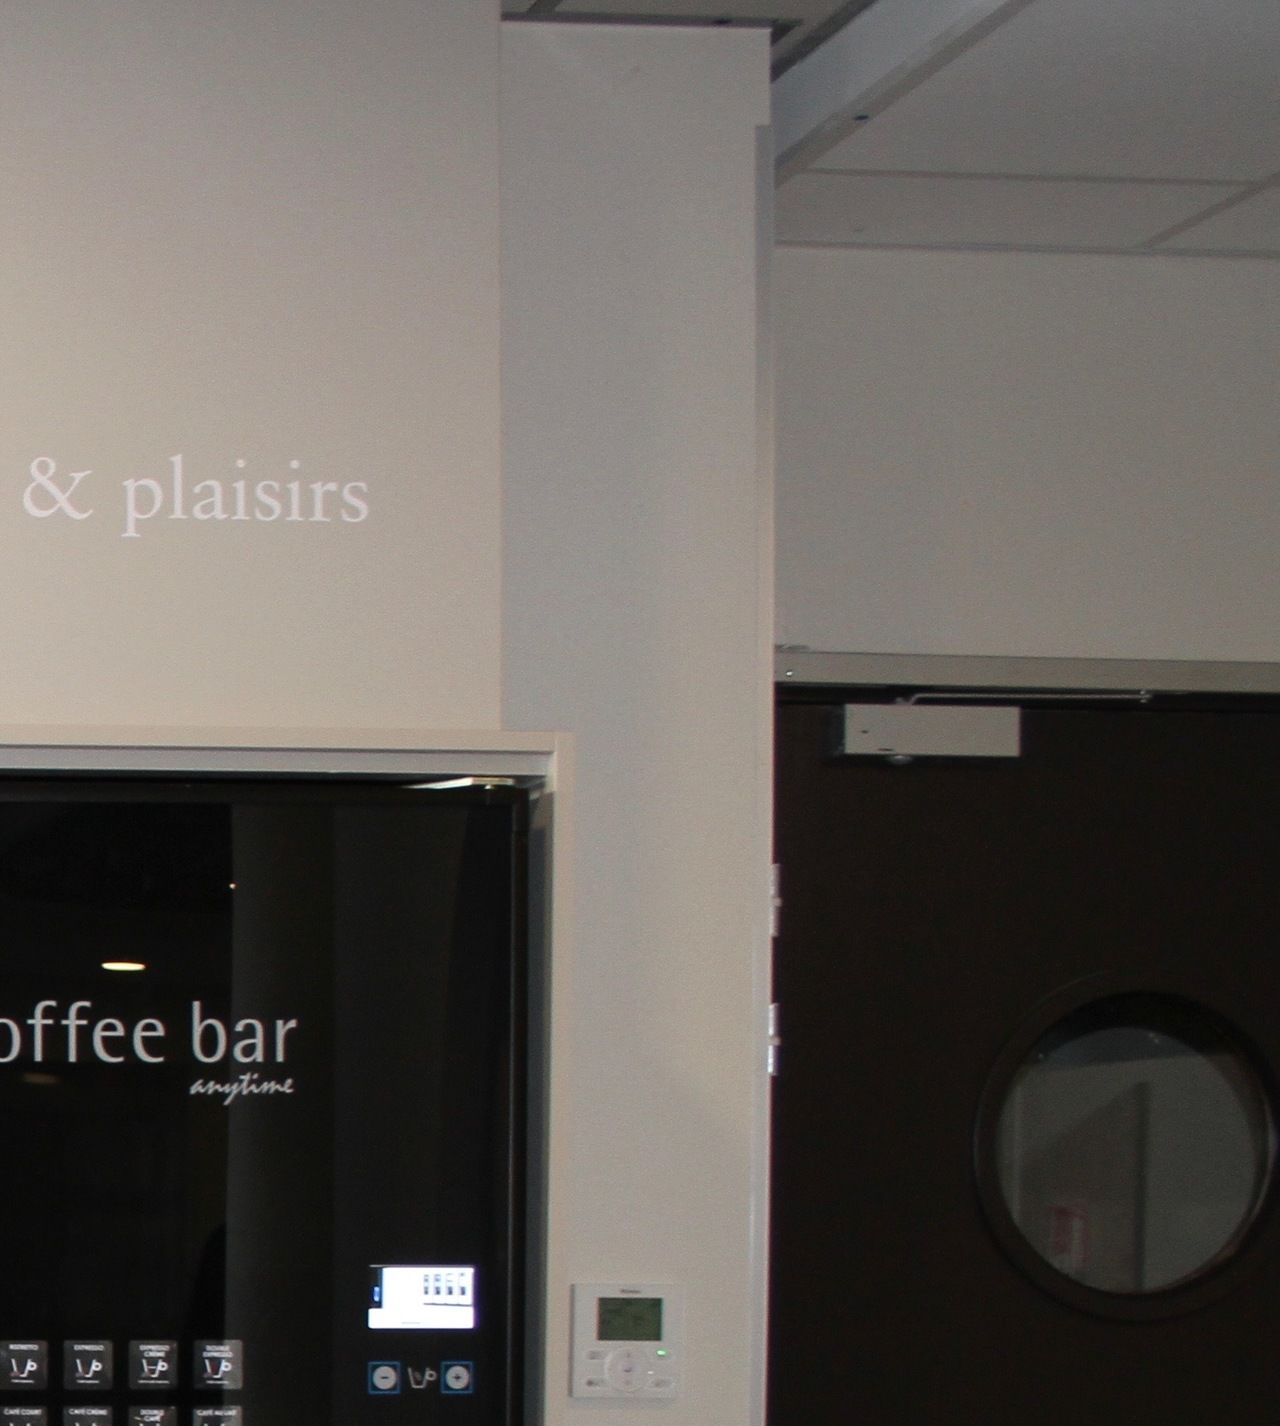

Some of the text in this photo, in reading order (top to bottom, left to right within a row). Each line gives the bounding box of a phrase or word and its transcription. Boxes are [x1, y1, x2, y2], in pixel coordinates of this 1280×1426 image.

[22, 454, 94, 521] &
[120, 454, 370, 538] plaisirs
[192, 1001, 299, 1064] bar
[189, 1073, 295, 1106] anytime
